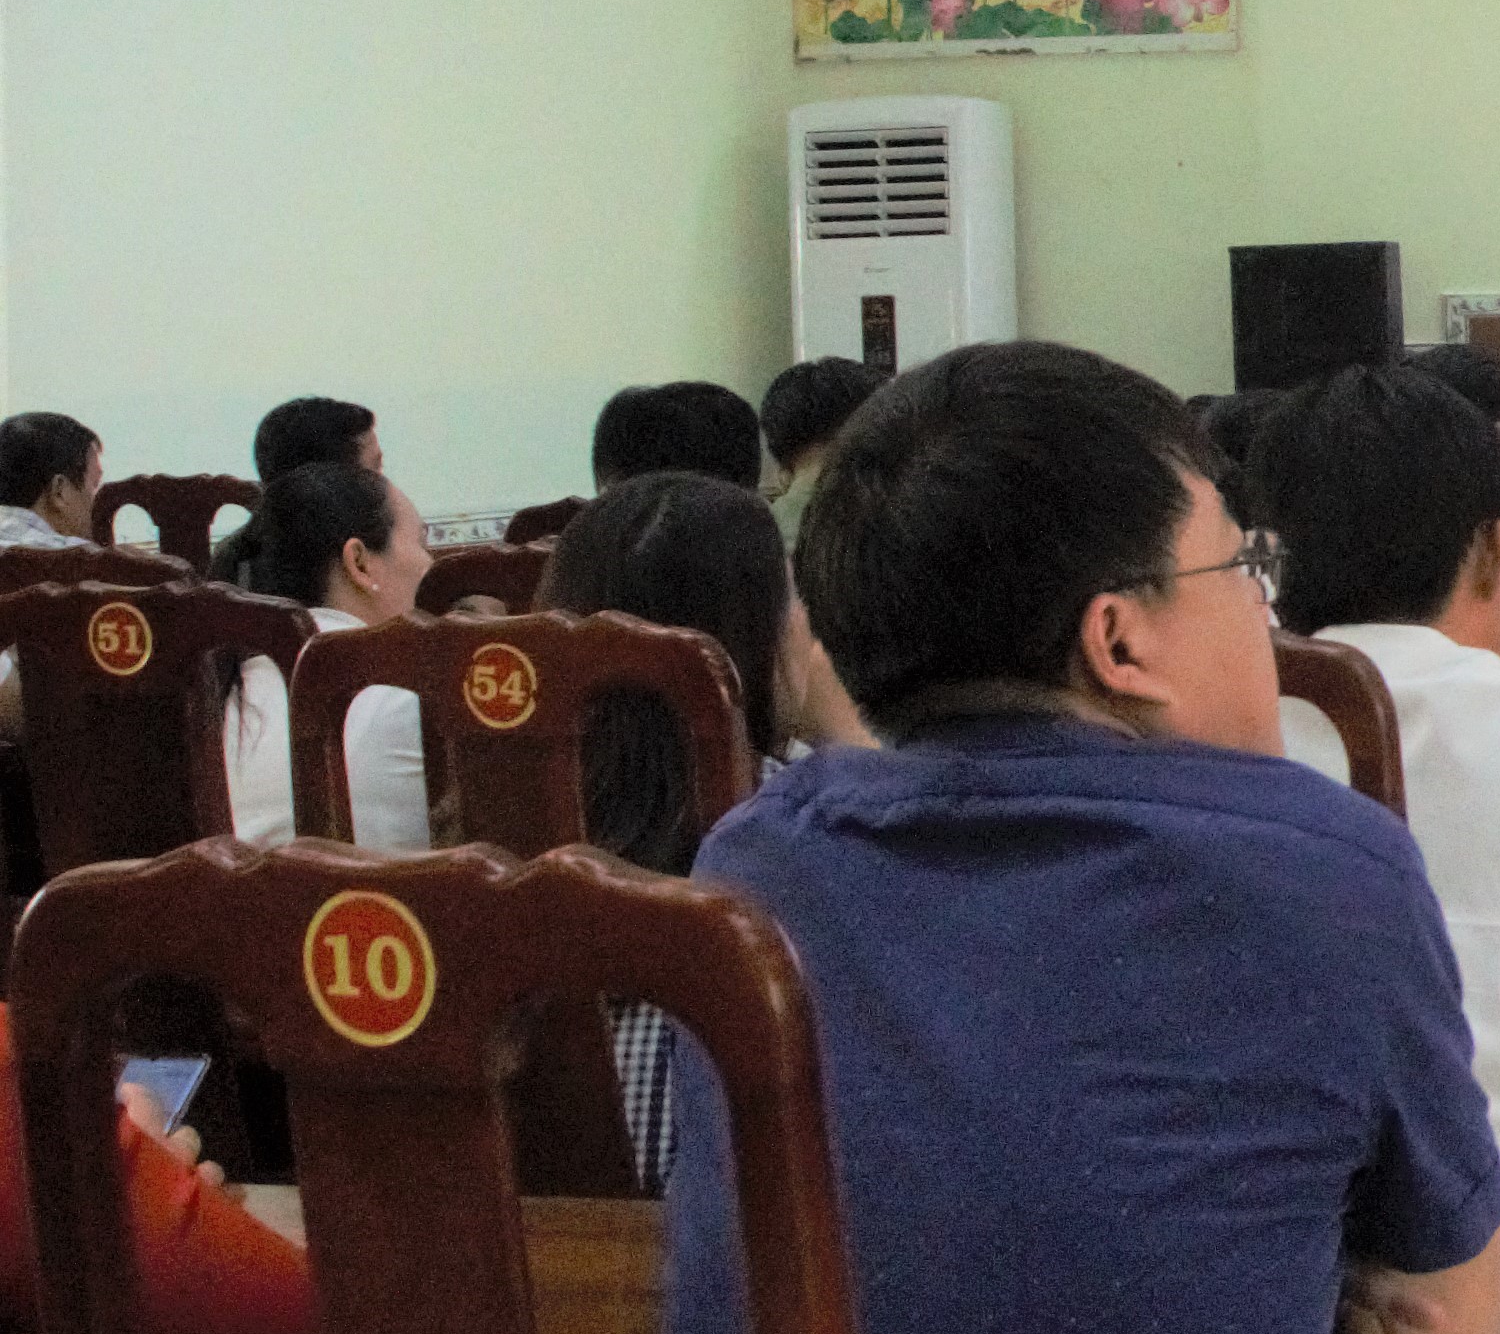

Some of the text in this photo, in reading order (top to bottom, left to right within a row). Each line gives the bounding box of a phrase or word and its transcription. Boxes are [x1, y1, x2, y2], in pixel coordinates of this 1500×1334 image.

[98, 622, 142, 655] 51
[472, 664, 526, 705] 54
[324, 934, 412, 1000] 10
